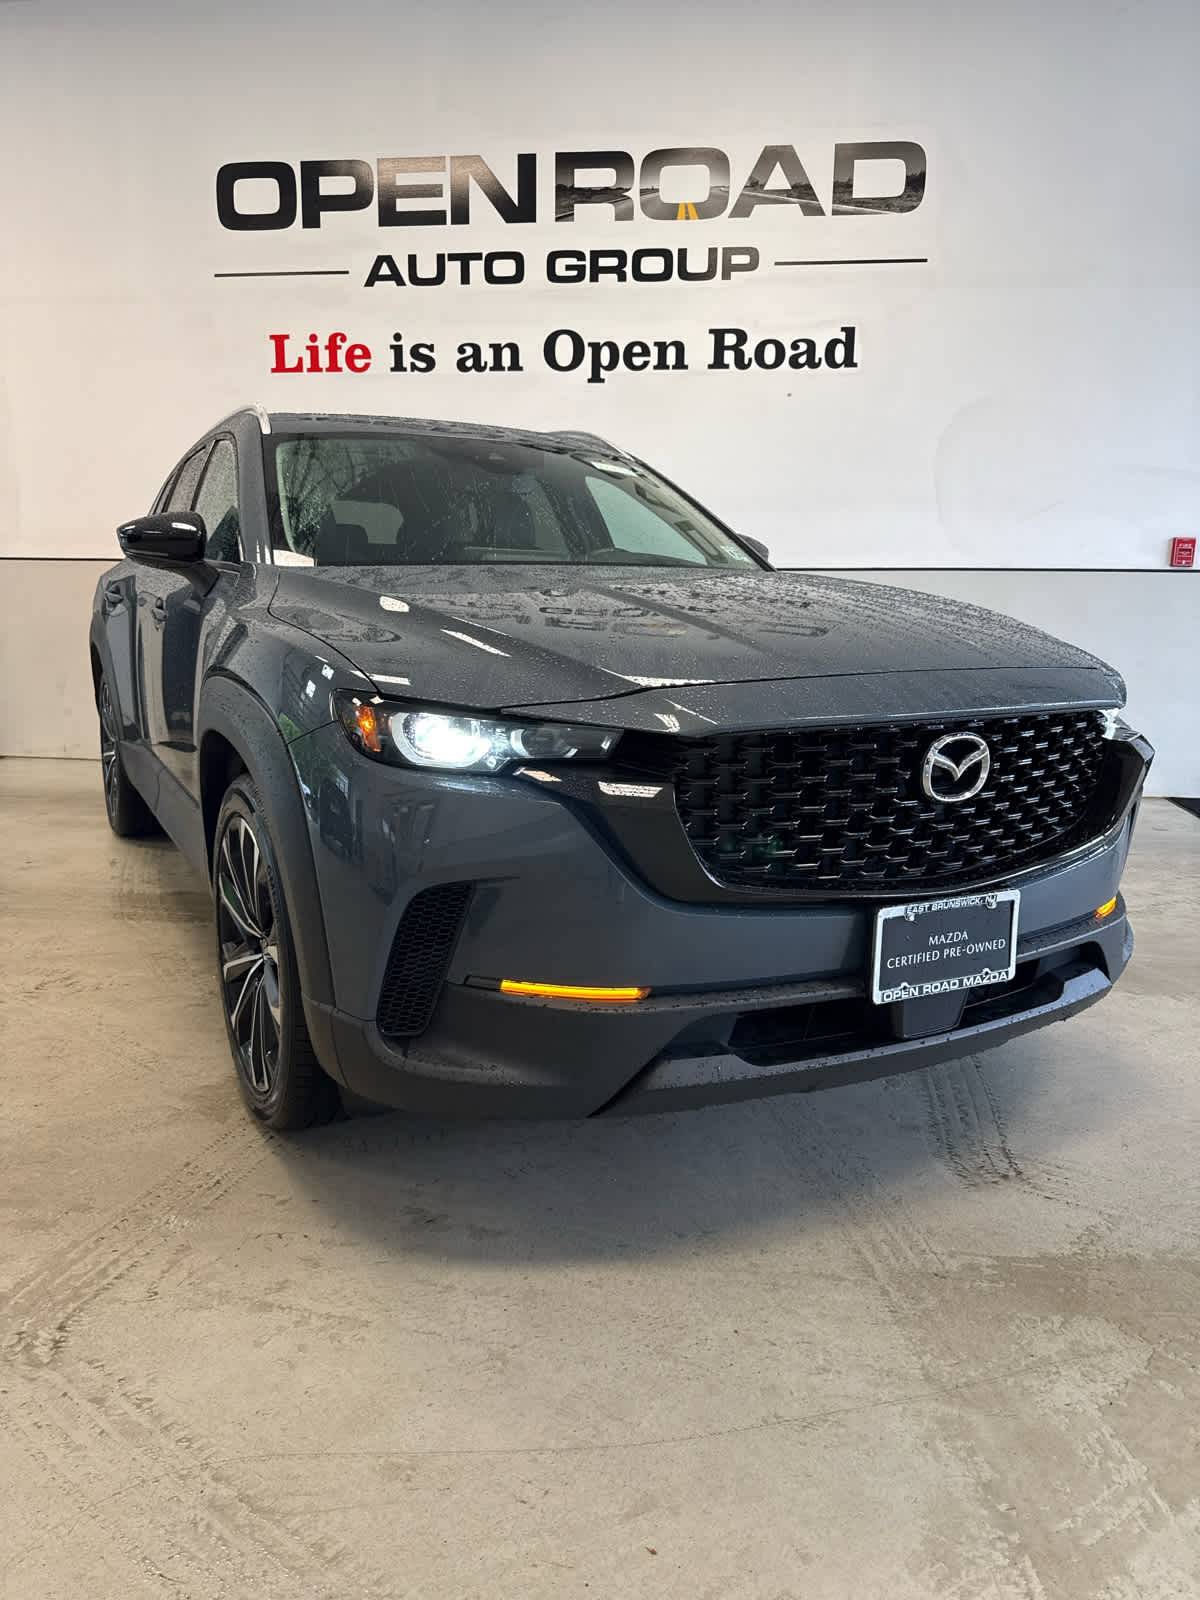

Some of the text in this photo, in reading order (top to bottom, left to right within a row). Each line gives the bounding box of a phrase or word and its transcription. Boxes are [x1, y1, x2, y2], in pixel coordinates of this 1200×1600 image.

[215, 141, 928, 231] OPEN ROAD
[364, 246, 760, 288] AUTO GROUP
[269, 326, 858, 384] Life is an Open Road
[906, 904, 930, 913] EAST
[928, 931, 969, 946] MAZDA
[887, 939, 1006, 969] CERTIFIED PRE-OWNED
[883, 972, 1008, 1001] OPEN ROAD MAZDA
